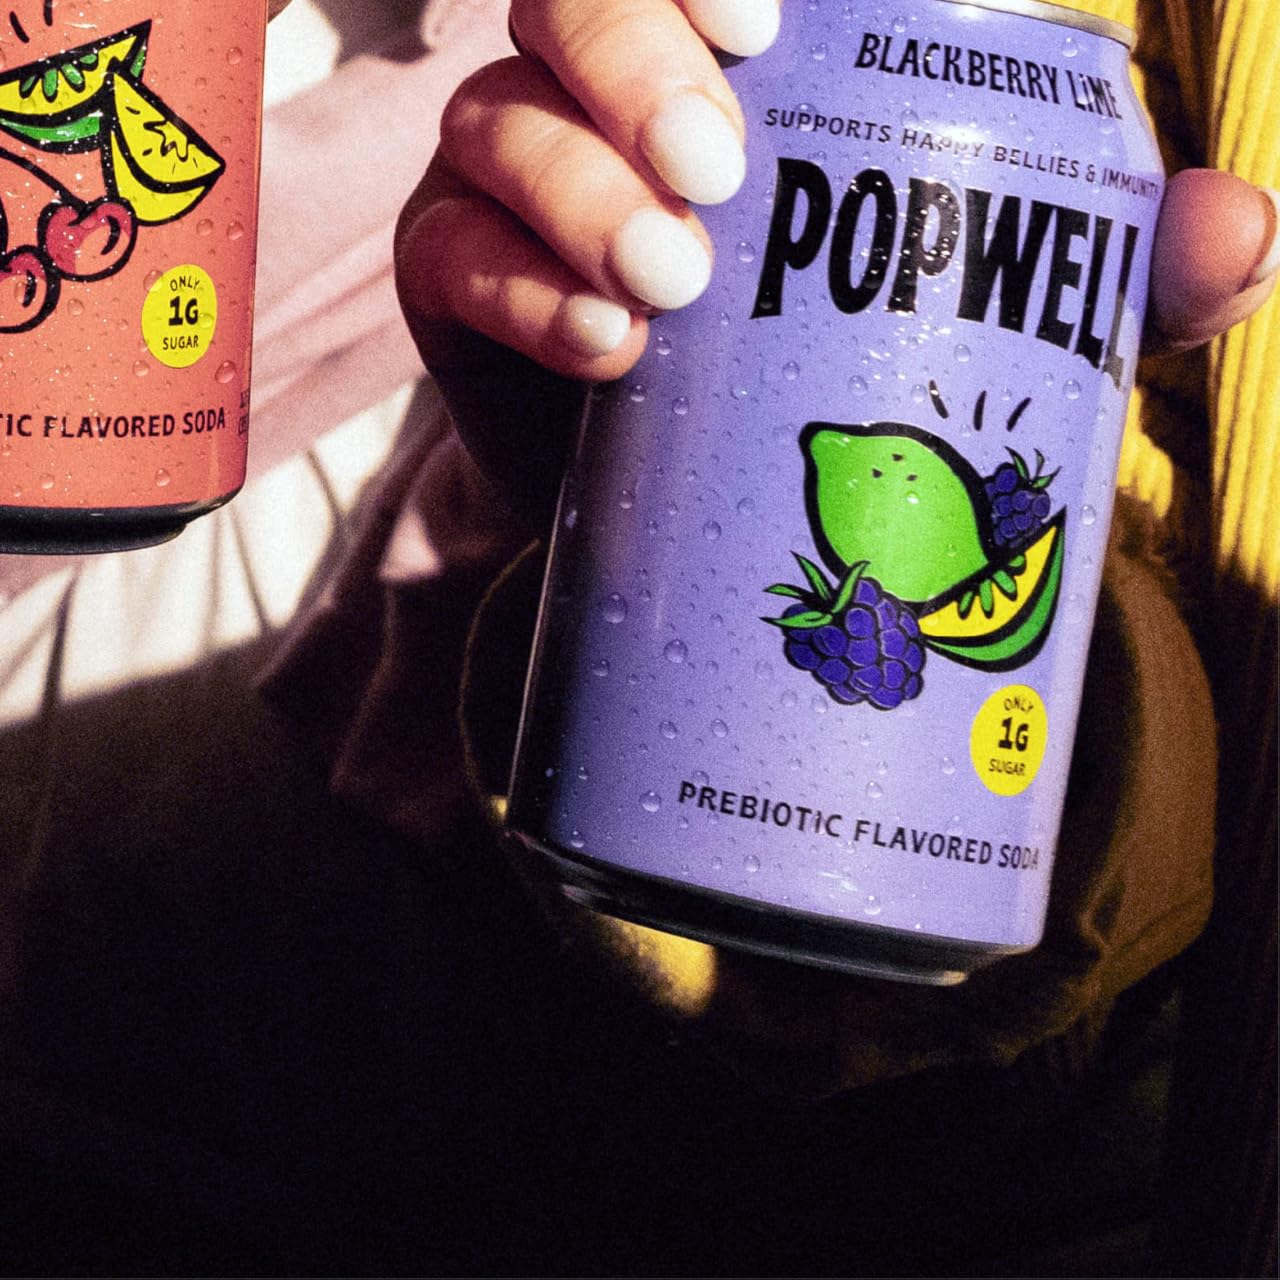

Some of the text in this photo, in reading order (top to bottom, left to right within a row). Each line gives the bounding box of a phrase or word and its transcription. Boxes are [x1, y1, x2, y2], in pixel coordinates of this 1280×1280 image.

[853, 32, 1063, 105] BLACKBERRY
[765, 107, 892, 144] SUPPORTS
[901, 127, 984, 159] HAPPY
[993, 145, 1081, 181] BELLIES
[1085, 163, 1096, 184] &
[170, 276, 201, 292] ONLY
[748, 157, 1140, 390] POPWELL
[168, 295, 200, 327] 1G
[162, 334, 200, 351] SUGAR
[42, 412, 176, 438] FLAVORED
[182, 406, 226, 435] SODA
[1003, 696, 1034, 714] ONLY
[997, 717, 1030, 753] 1G
[988, 758, 1027, 777] SUGAR
[678, 780, 1040, 872] PREBIOTIC FLAVORED SODA
